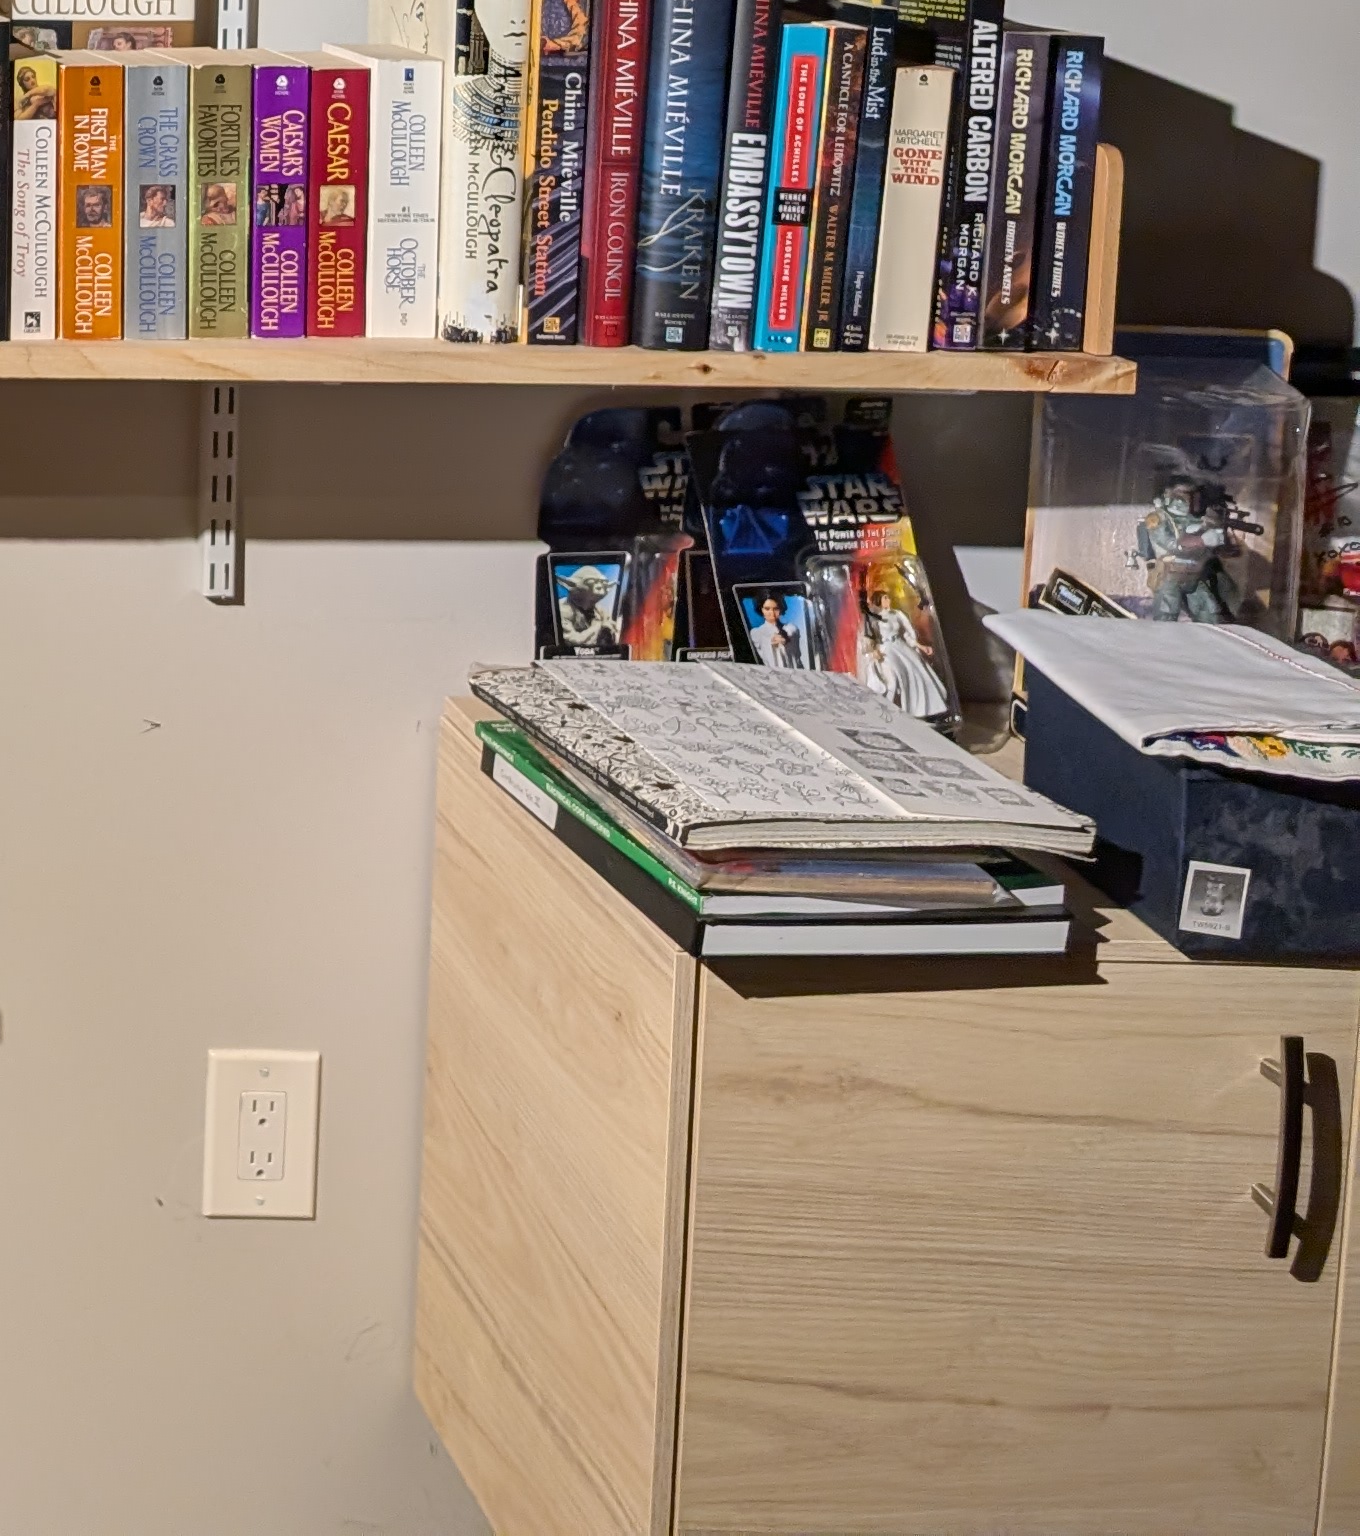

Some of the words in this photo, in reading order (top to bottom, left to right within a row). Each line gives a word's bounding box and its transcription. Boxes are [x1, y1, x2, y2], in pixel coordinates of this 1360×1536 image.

[968, 19, 997, 111] ALTERED
[326, 103, 351, 181] CAESAR
[963, 116, 990, 201] CARBON
[718, 133, 767, 310] EMBASSYTOWN
[798, 475, 899, 499] STAR
[800, 498, 905, 525] WARS
